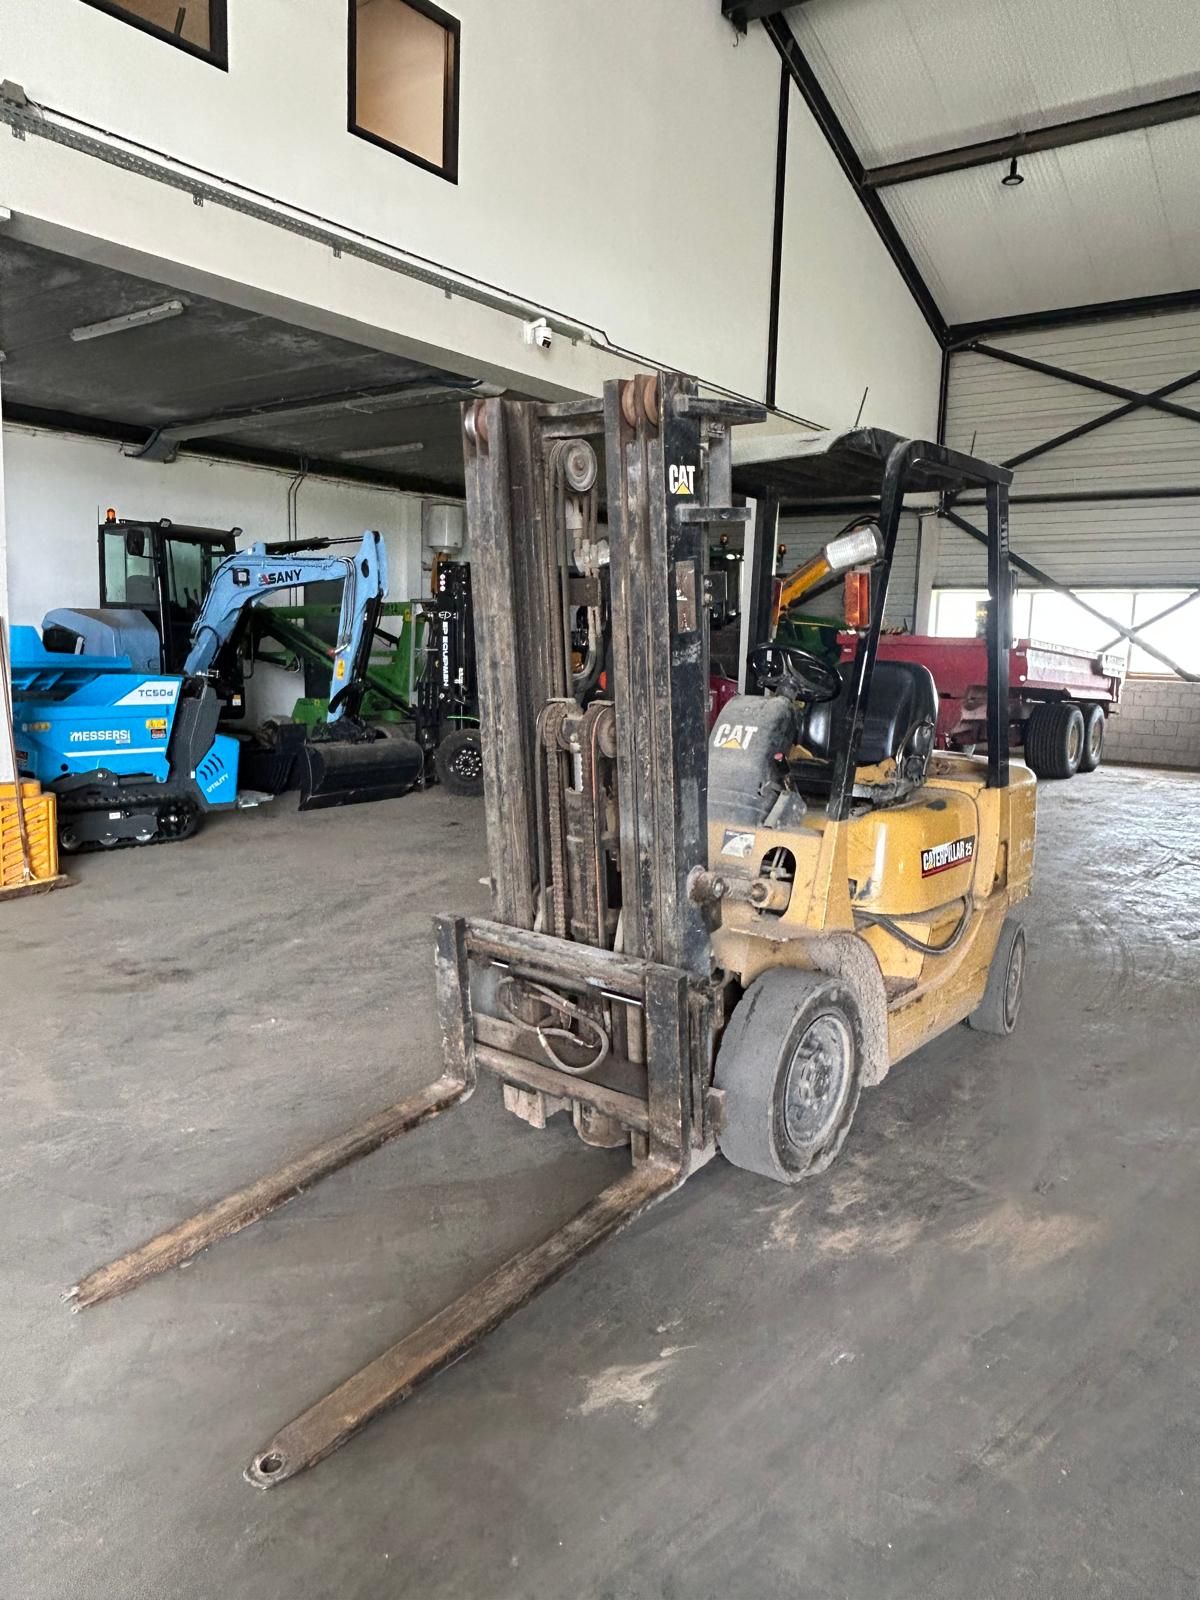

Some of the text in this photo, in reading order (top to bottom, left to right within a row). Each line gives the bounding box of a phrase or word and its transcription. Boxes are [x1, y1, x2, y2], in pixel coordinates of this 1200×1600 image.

[669, 464, 696, 495] CAT
[268, 569, 302, 585] SANY
[442, 621, 449, 634] EP
[714, 723, 758, 750] CAT
[923, 840, 965, 871] CATERPILLAR
